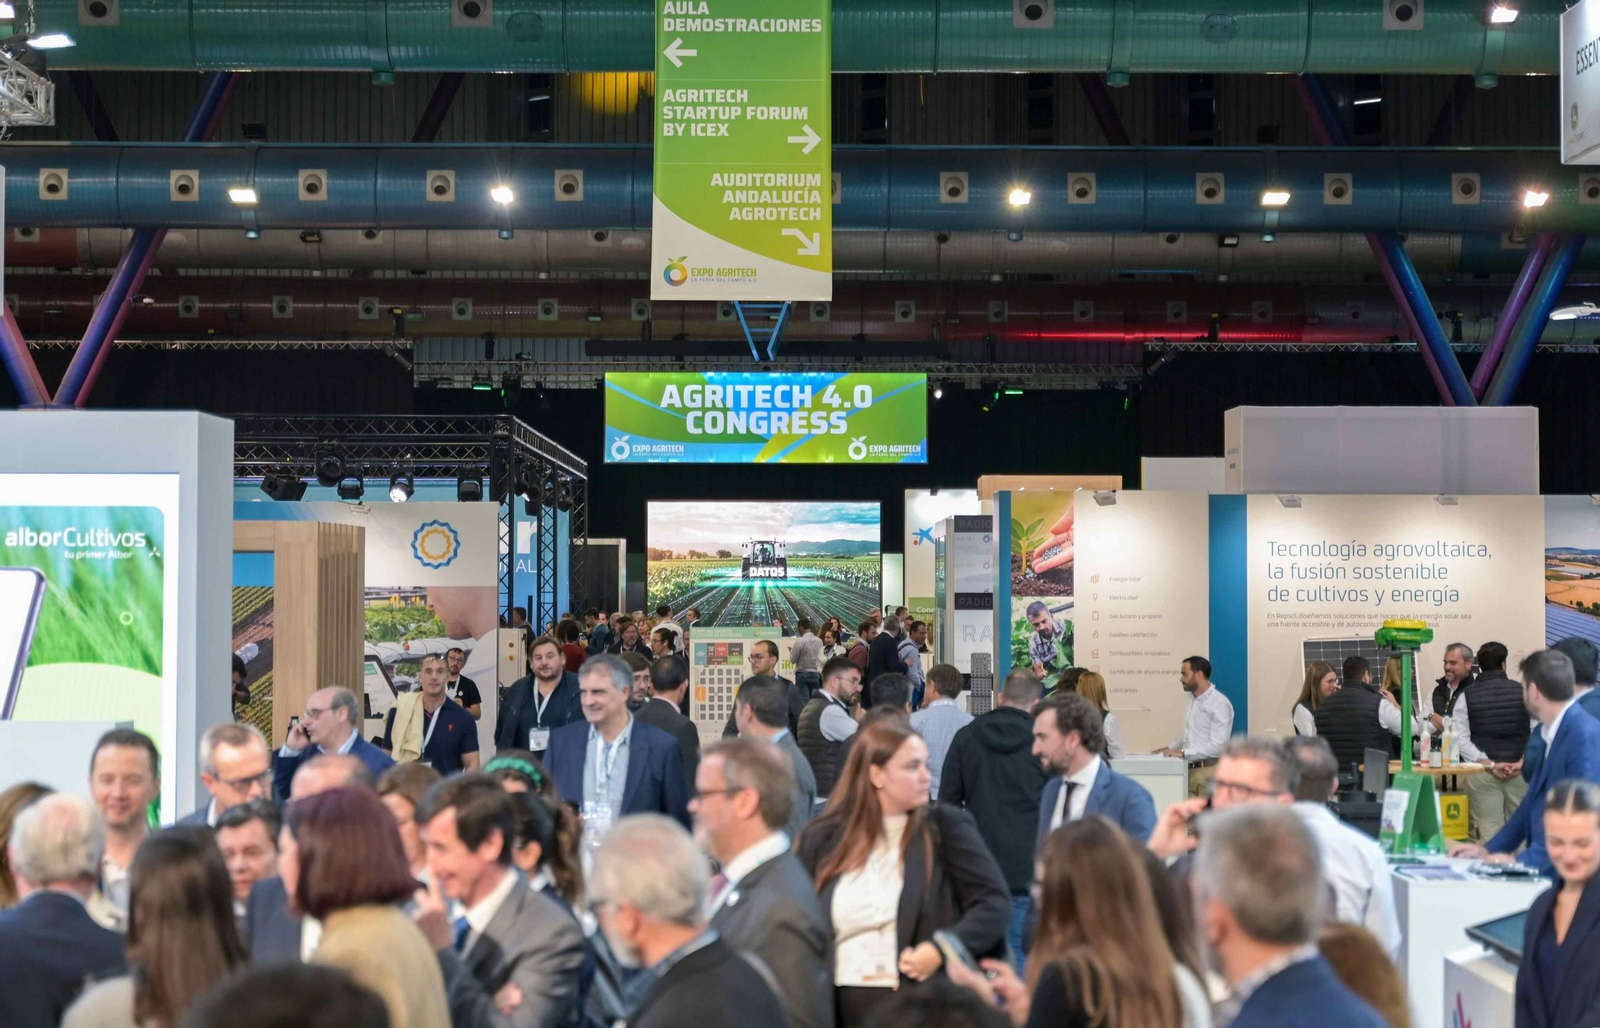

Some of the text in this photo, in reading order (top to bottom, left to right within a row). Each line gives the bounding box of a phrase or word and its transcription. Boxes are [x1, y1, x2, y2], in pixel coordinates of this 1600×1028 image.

[663, 2, 709, 14] AULA
[663, 18, 822, 32] DEMOSTRACIONES
[1576, 36, 1600, 76] ESSEN
[663, 89, 748, 102] AGRITECH
[663, 106, 808, 120] STARTUP FORUM
[663, 123, 729, 136] BY ICEX
[710, 173, 821, 186] AUDITORIUM
[722, 187, 822, 203] ANDALUCÍA
[729, 207, 821, 220] AGROTECH
[691, 268, 757, 277] EXPO AGRITECH
[660, 384, 872, 408] AGRITECH 4.0
[686, 411, 848, 434] CONGRESS
[959, 520, 992, 529] RADIO
[76, 550, 106, 561] primer
[108, 550, 133, 559] Albor
[1268, 540, 1492, 561] Tecnología agrovoltaica,
[750, 567, 785, 576] DATOS
[1268, 562, 1448, 580] la fusión sostenible
[959, 597, 992, 606] RADIO
[1268, 585, 1460, 606] de cultivos y energía
